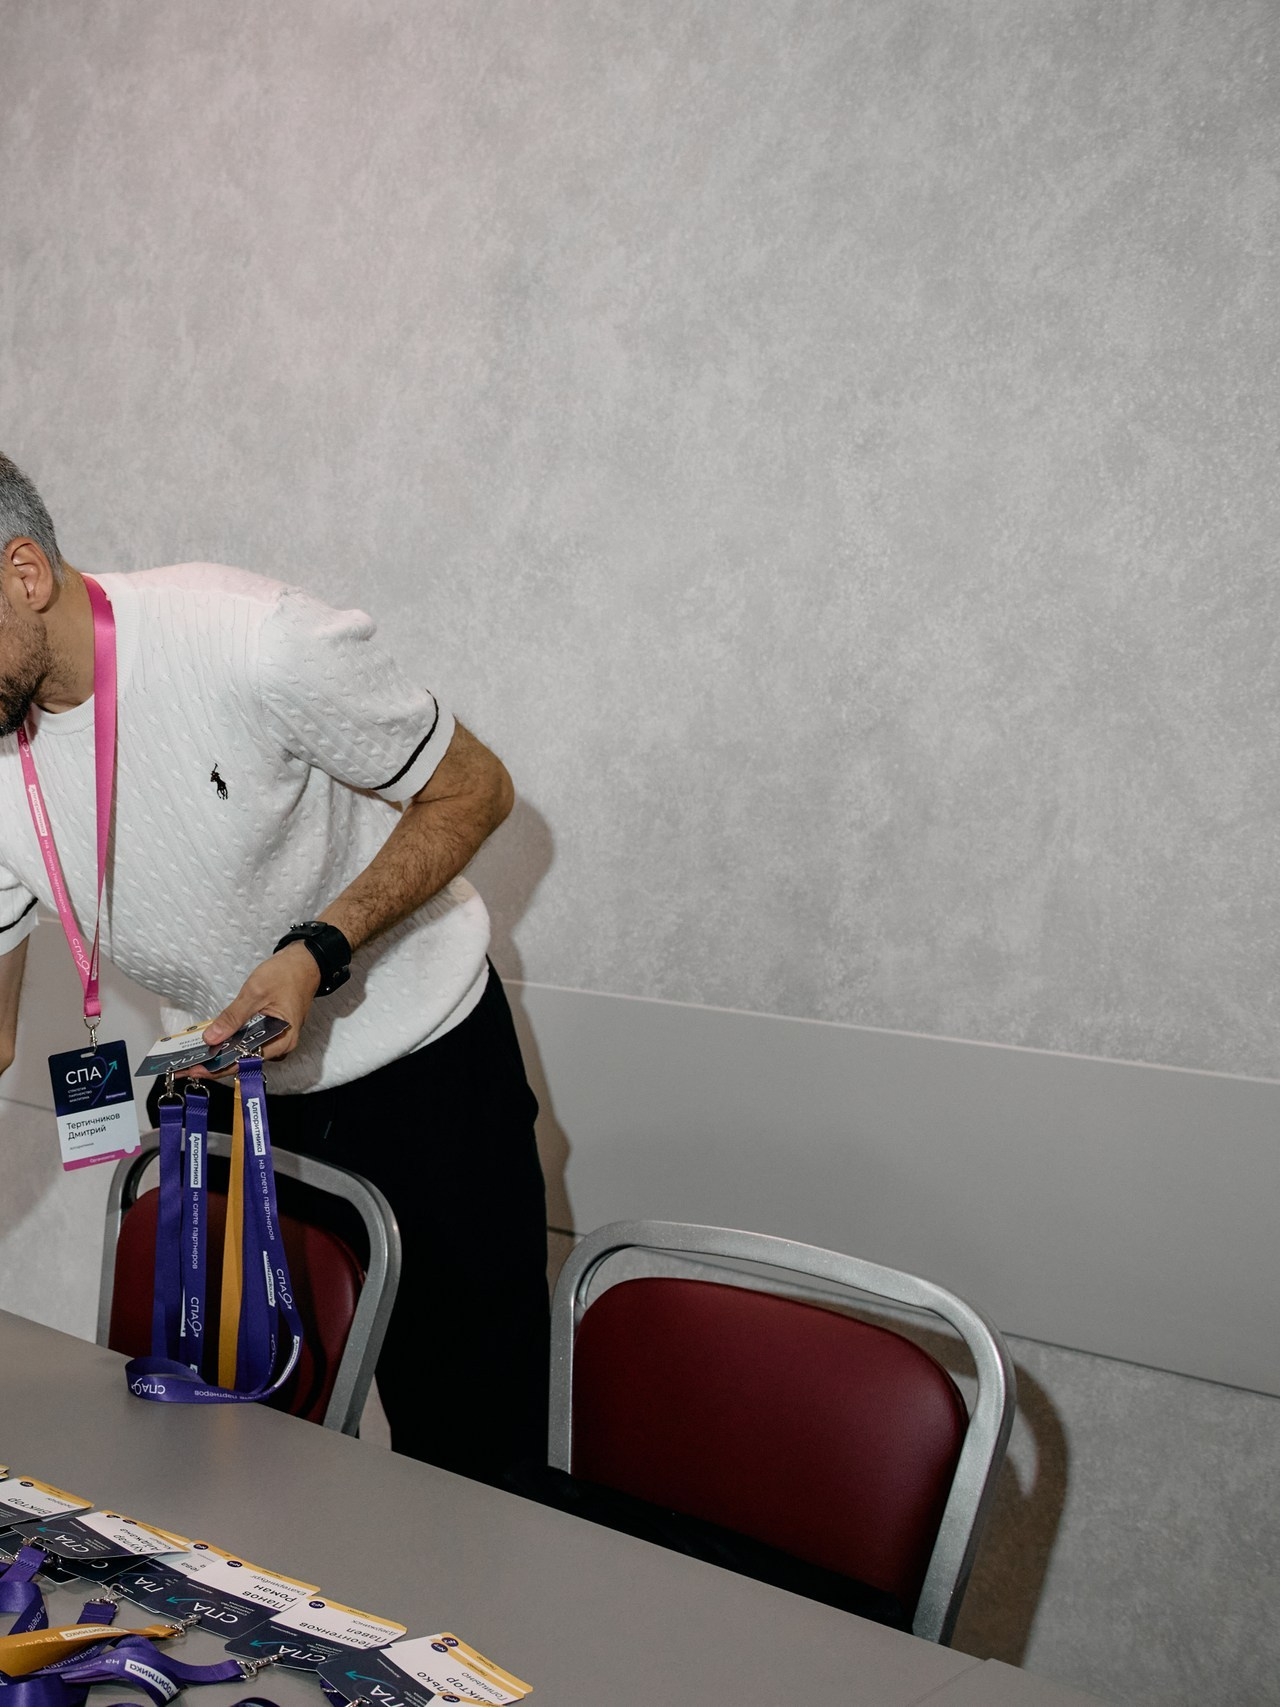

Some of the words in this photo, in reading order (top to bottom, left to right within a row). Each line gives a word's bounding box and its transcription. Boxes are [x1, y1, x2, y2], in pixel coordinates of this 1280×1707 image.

[170, 1052, 206, 1066] СПА
[65, 1066, 102, 1085] СПА
[66, 1113, 121, 1131] Тертичников
[251, 1101, 263, 1153] Алгоритмика
[67, 1125, 107, 1140] Дмитрий
[193, 1136, 201, 1186] Алгоритмика
[258, 1159, 265, 1170] на
[260, 1171, 268, 1195] слете
[192, 1191, 199, 1202] на
[264, 1196, 275, 1241] партнеров
[191, 1227, 199, 1270] партнеров
[276, 1268, 287, 1293] СПА
[190, 1296, 200, 1323] СПА
[141, 1384, 166, 1395] СПА
[54, 1534, 90, 1553] СПА
[242, 1590, 286, 1610] Панов
[254, 1584, 297, 1603] Роман
[193, 1602, 239, 1624] СПА
[299, 1622, 373, 1649] Леонтенков
[347, 1628, 387, 1643] Павел
[278, 1645, 327, 1662] СПА
[370, 1684, 406, 1707] ПА
[461, 1672, 507, 1701] Голицыно
